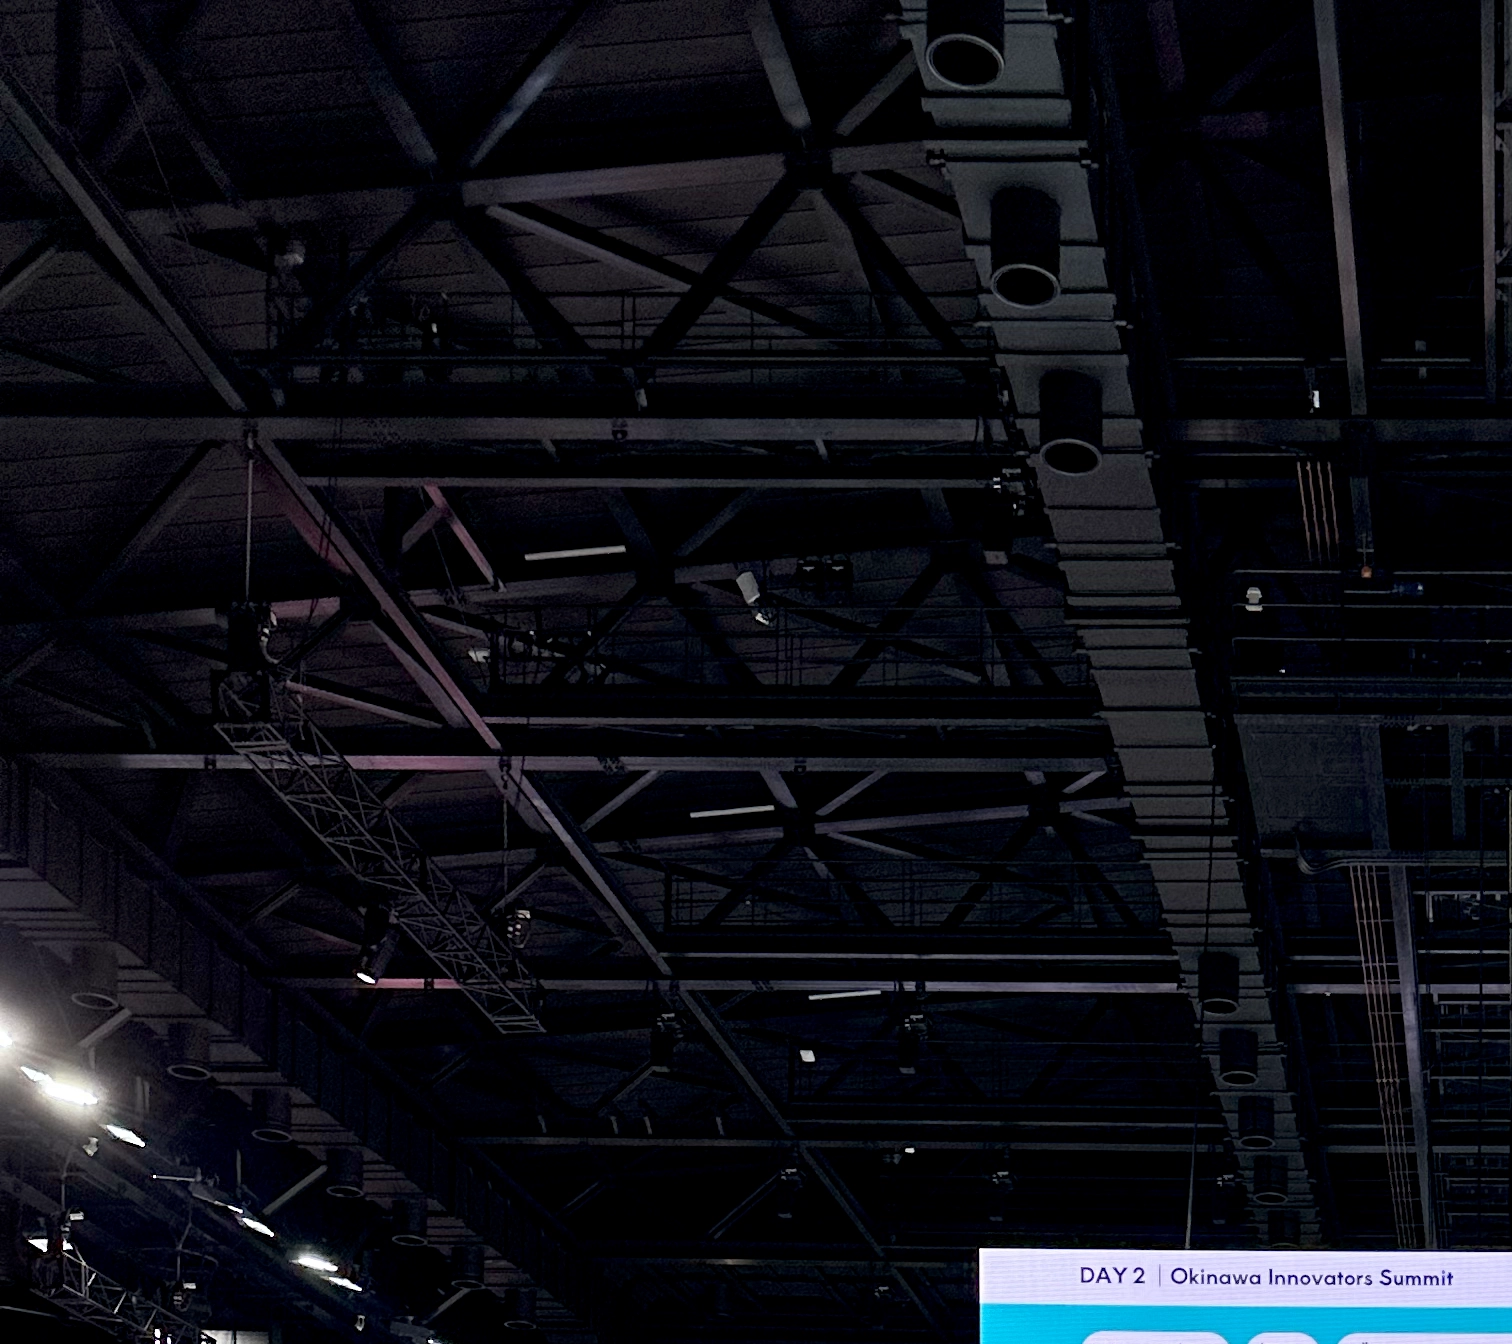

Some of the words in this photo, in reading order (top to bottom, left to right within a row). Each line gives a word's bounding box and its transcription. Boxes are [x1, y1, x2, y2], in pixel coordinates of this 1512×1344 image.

[1080, 1267, 1129, 1285] DAY
[1133, 1266, 1146, 1284] 2
[1171, 1267, 1262, 1286] Okinawa
[1268, 1268, 1373, 1287] Innovators
[1379, 1269, 1455, 1288] Summit
